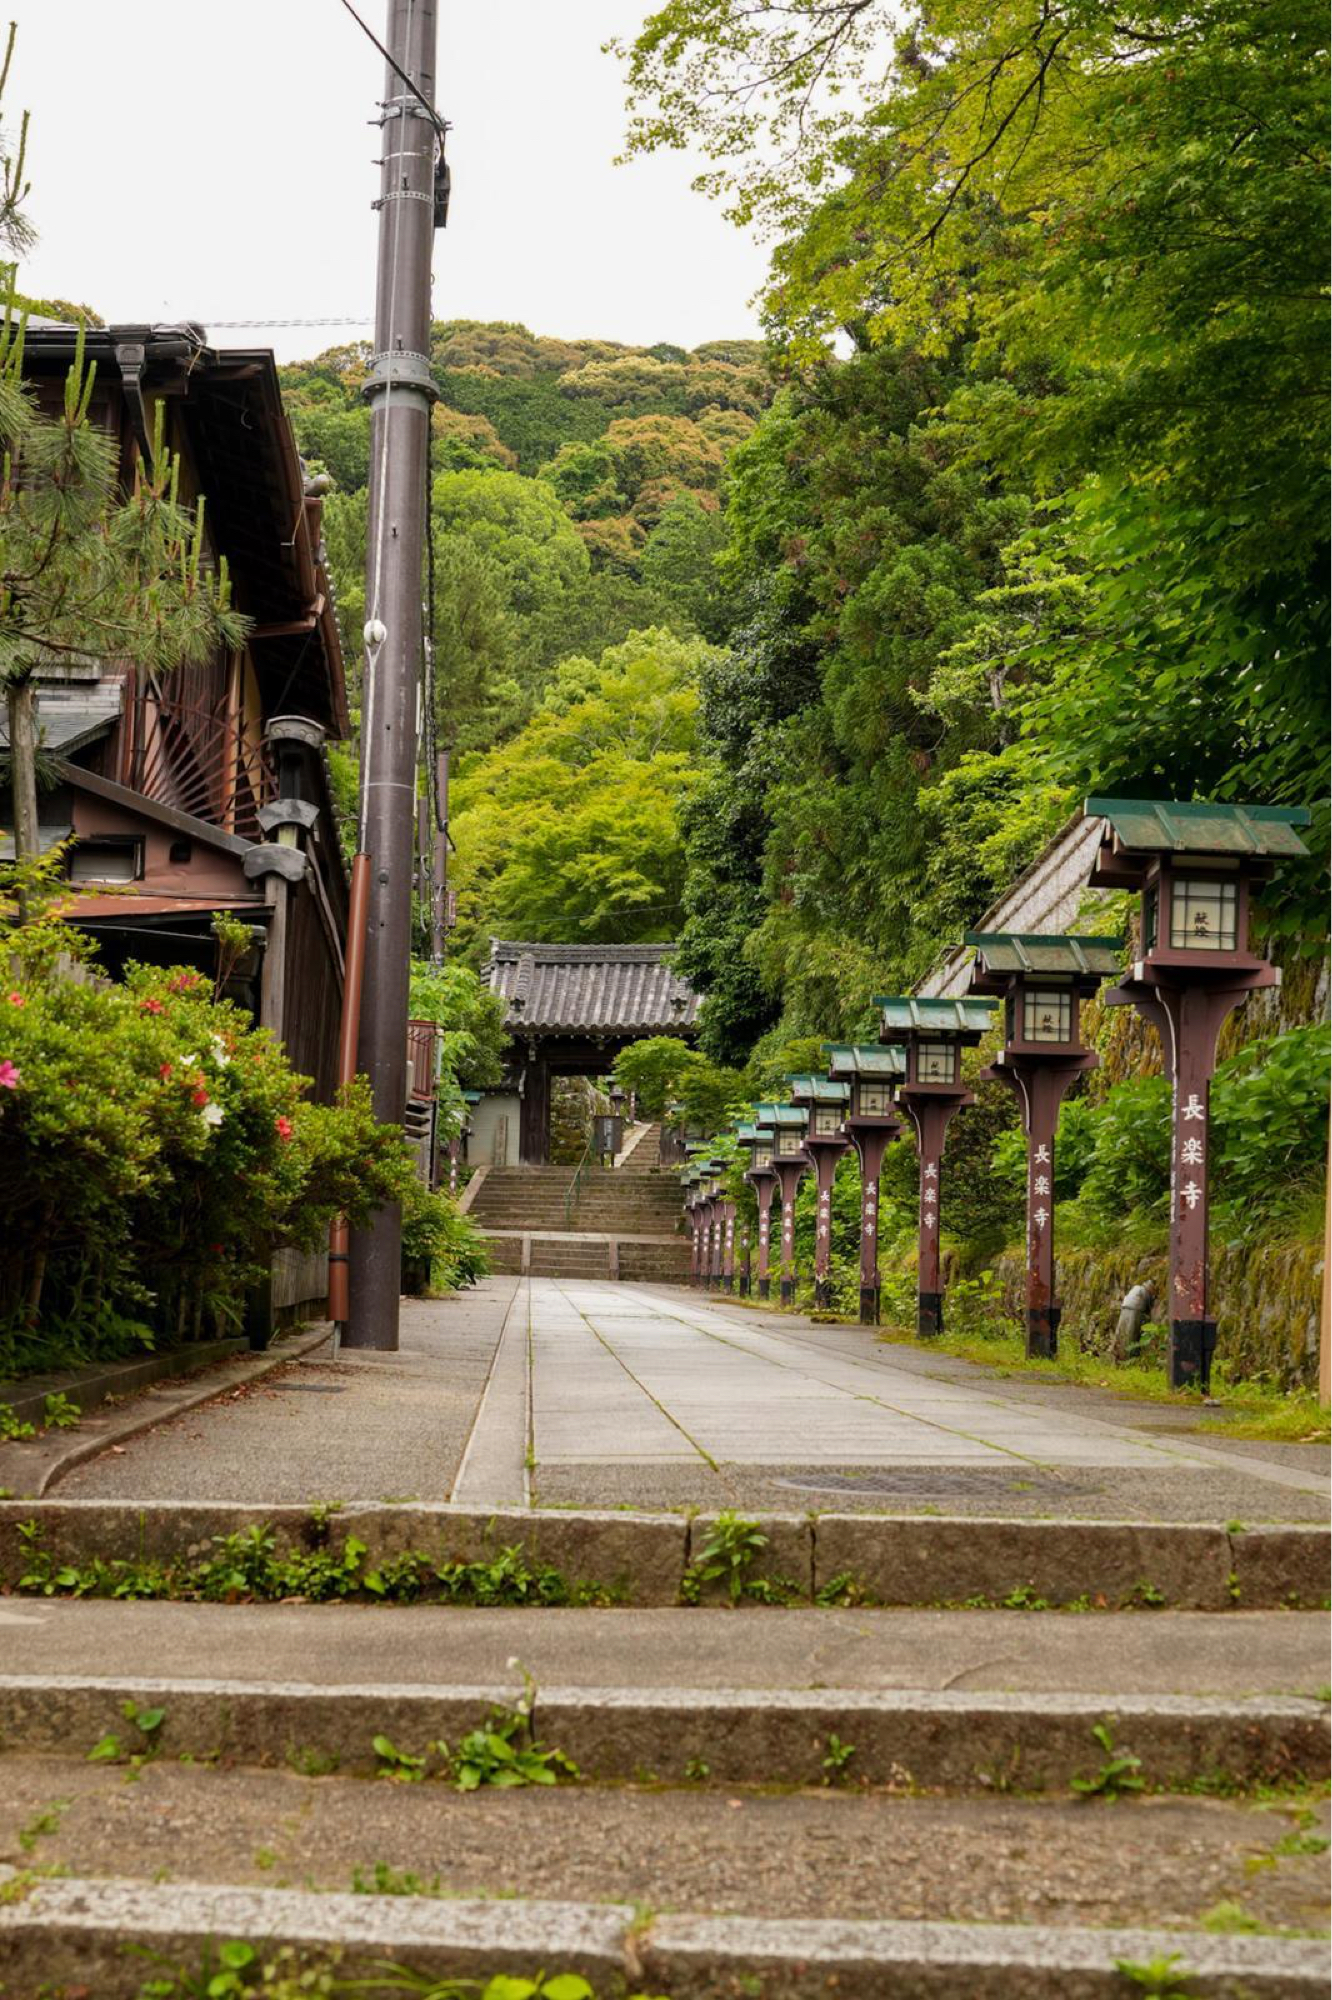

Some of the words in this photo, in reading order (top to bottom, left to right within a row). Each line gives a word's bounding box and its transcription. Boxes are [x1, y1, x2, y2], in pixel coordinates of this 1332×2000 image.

[1034, 1144, 1050, 1230] 長楽寺
[1180, 1094, 1205, 1210] 長楽寺
[923, 1163, 937, 1229] 長楽寺
